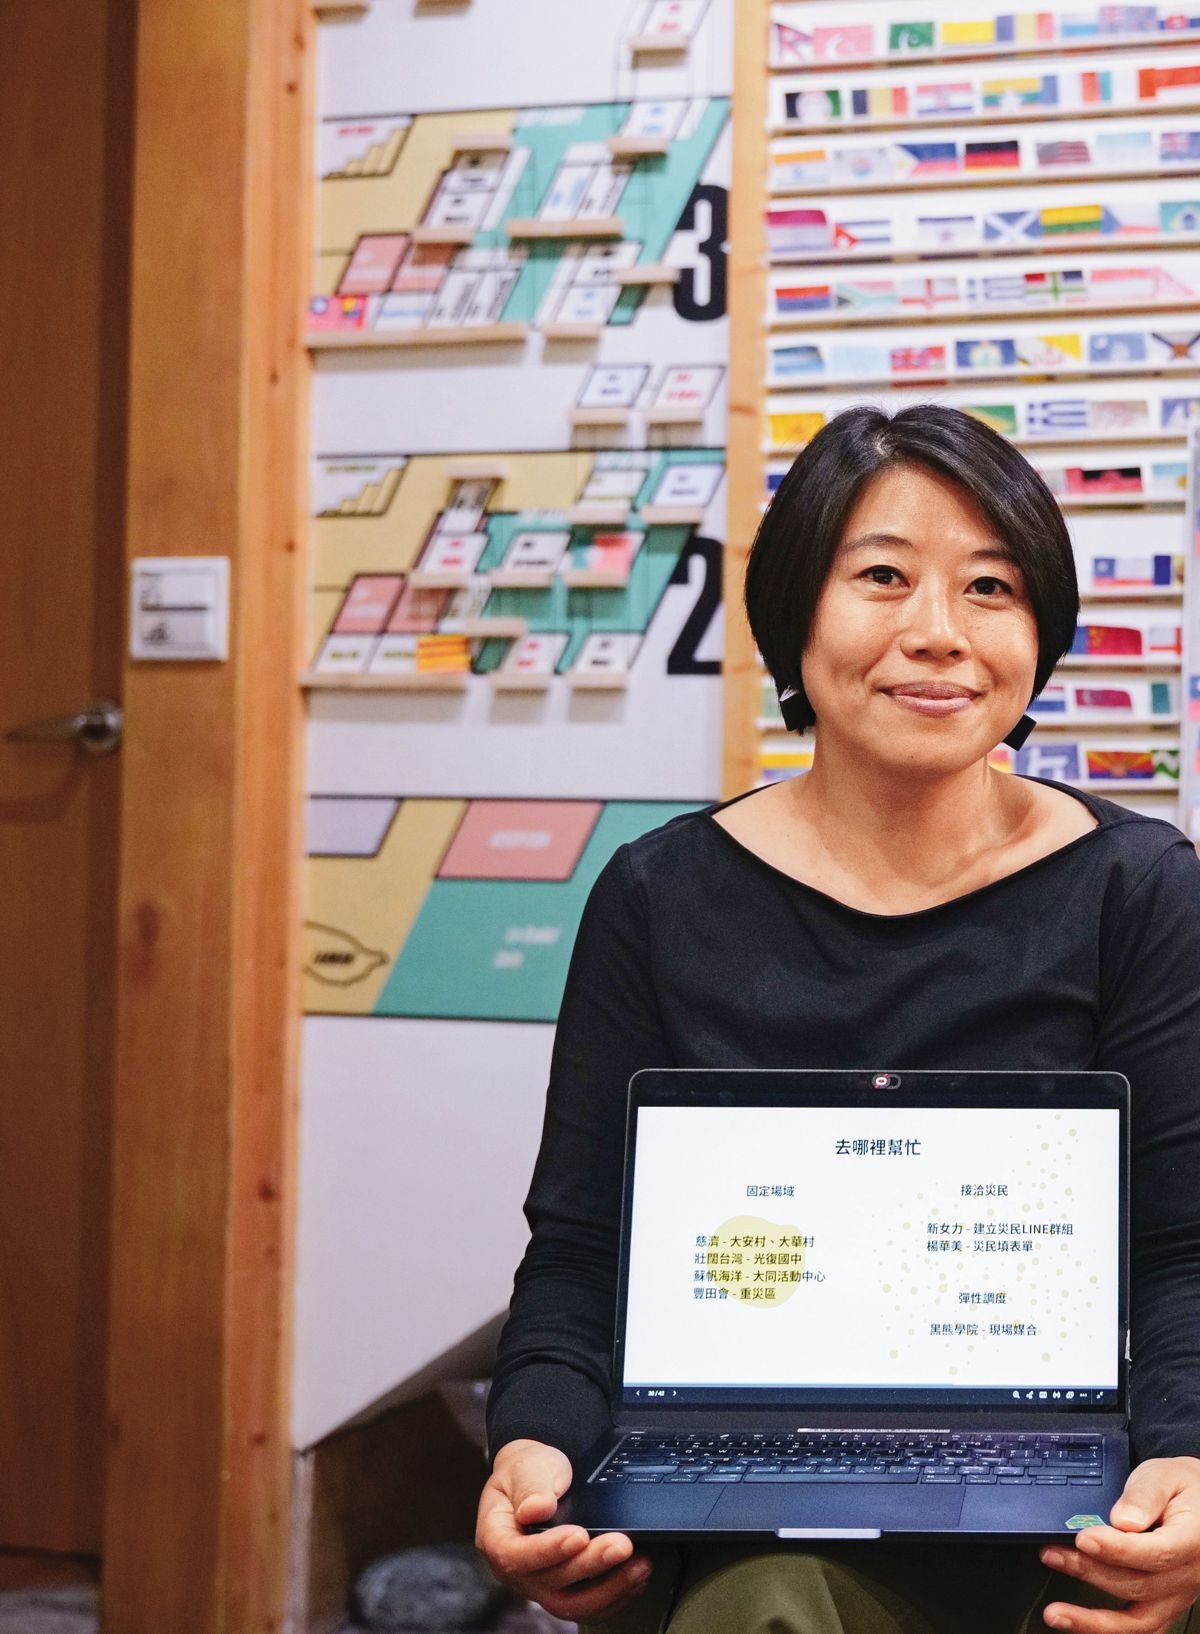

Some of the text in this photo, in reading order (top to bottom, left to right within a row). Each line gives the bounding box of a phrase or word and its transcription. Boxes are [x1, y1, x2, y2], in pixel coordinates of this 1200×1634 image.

[673, 183, 729, 322] 3
[667, 536, 724, 675] 2
[835, 1138, 922, 1156] 去哪裡幫忙
[746, 1185, 795, 1198] 固定場域
[961, 1184, 1009, 1197] 接洽災民
[927, 1222, 963, 1236] 新女力
[973, 1222, 1074, 1236] 建立災民LINE群組
[730, 1235, 815, 1248] 大安村、大華村
[753, 1252, 802, 1266] 光復國中
[752, 1269, 827, 1283] 大同活動中心
[740, 1287, 777, 1300] 重災區
[958, 1291, 1008, 1305] 彈性調度
[989, 1323, 1038, 1337] 現場媒合
